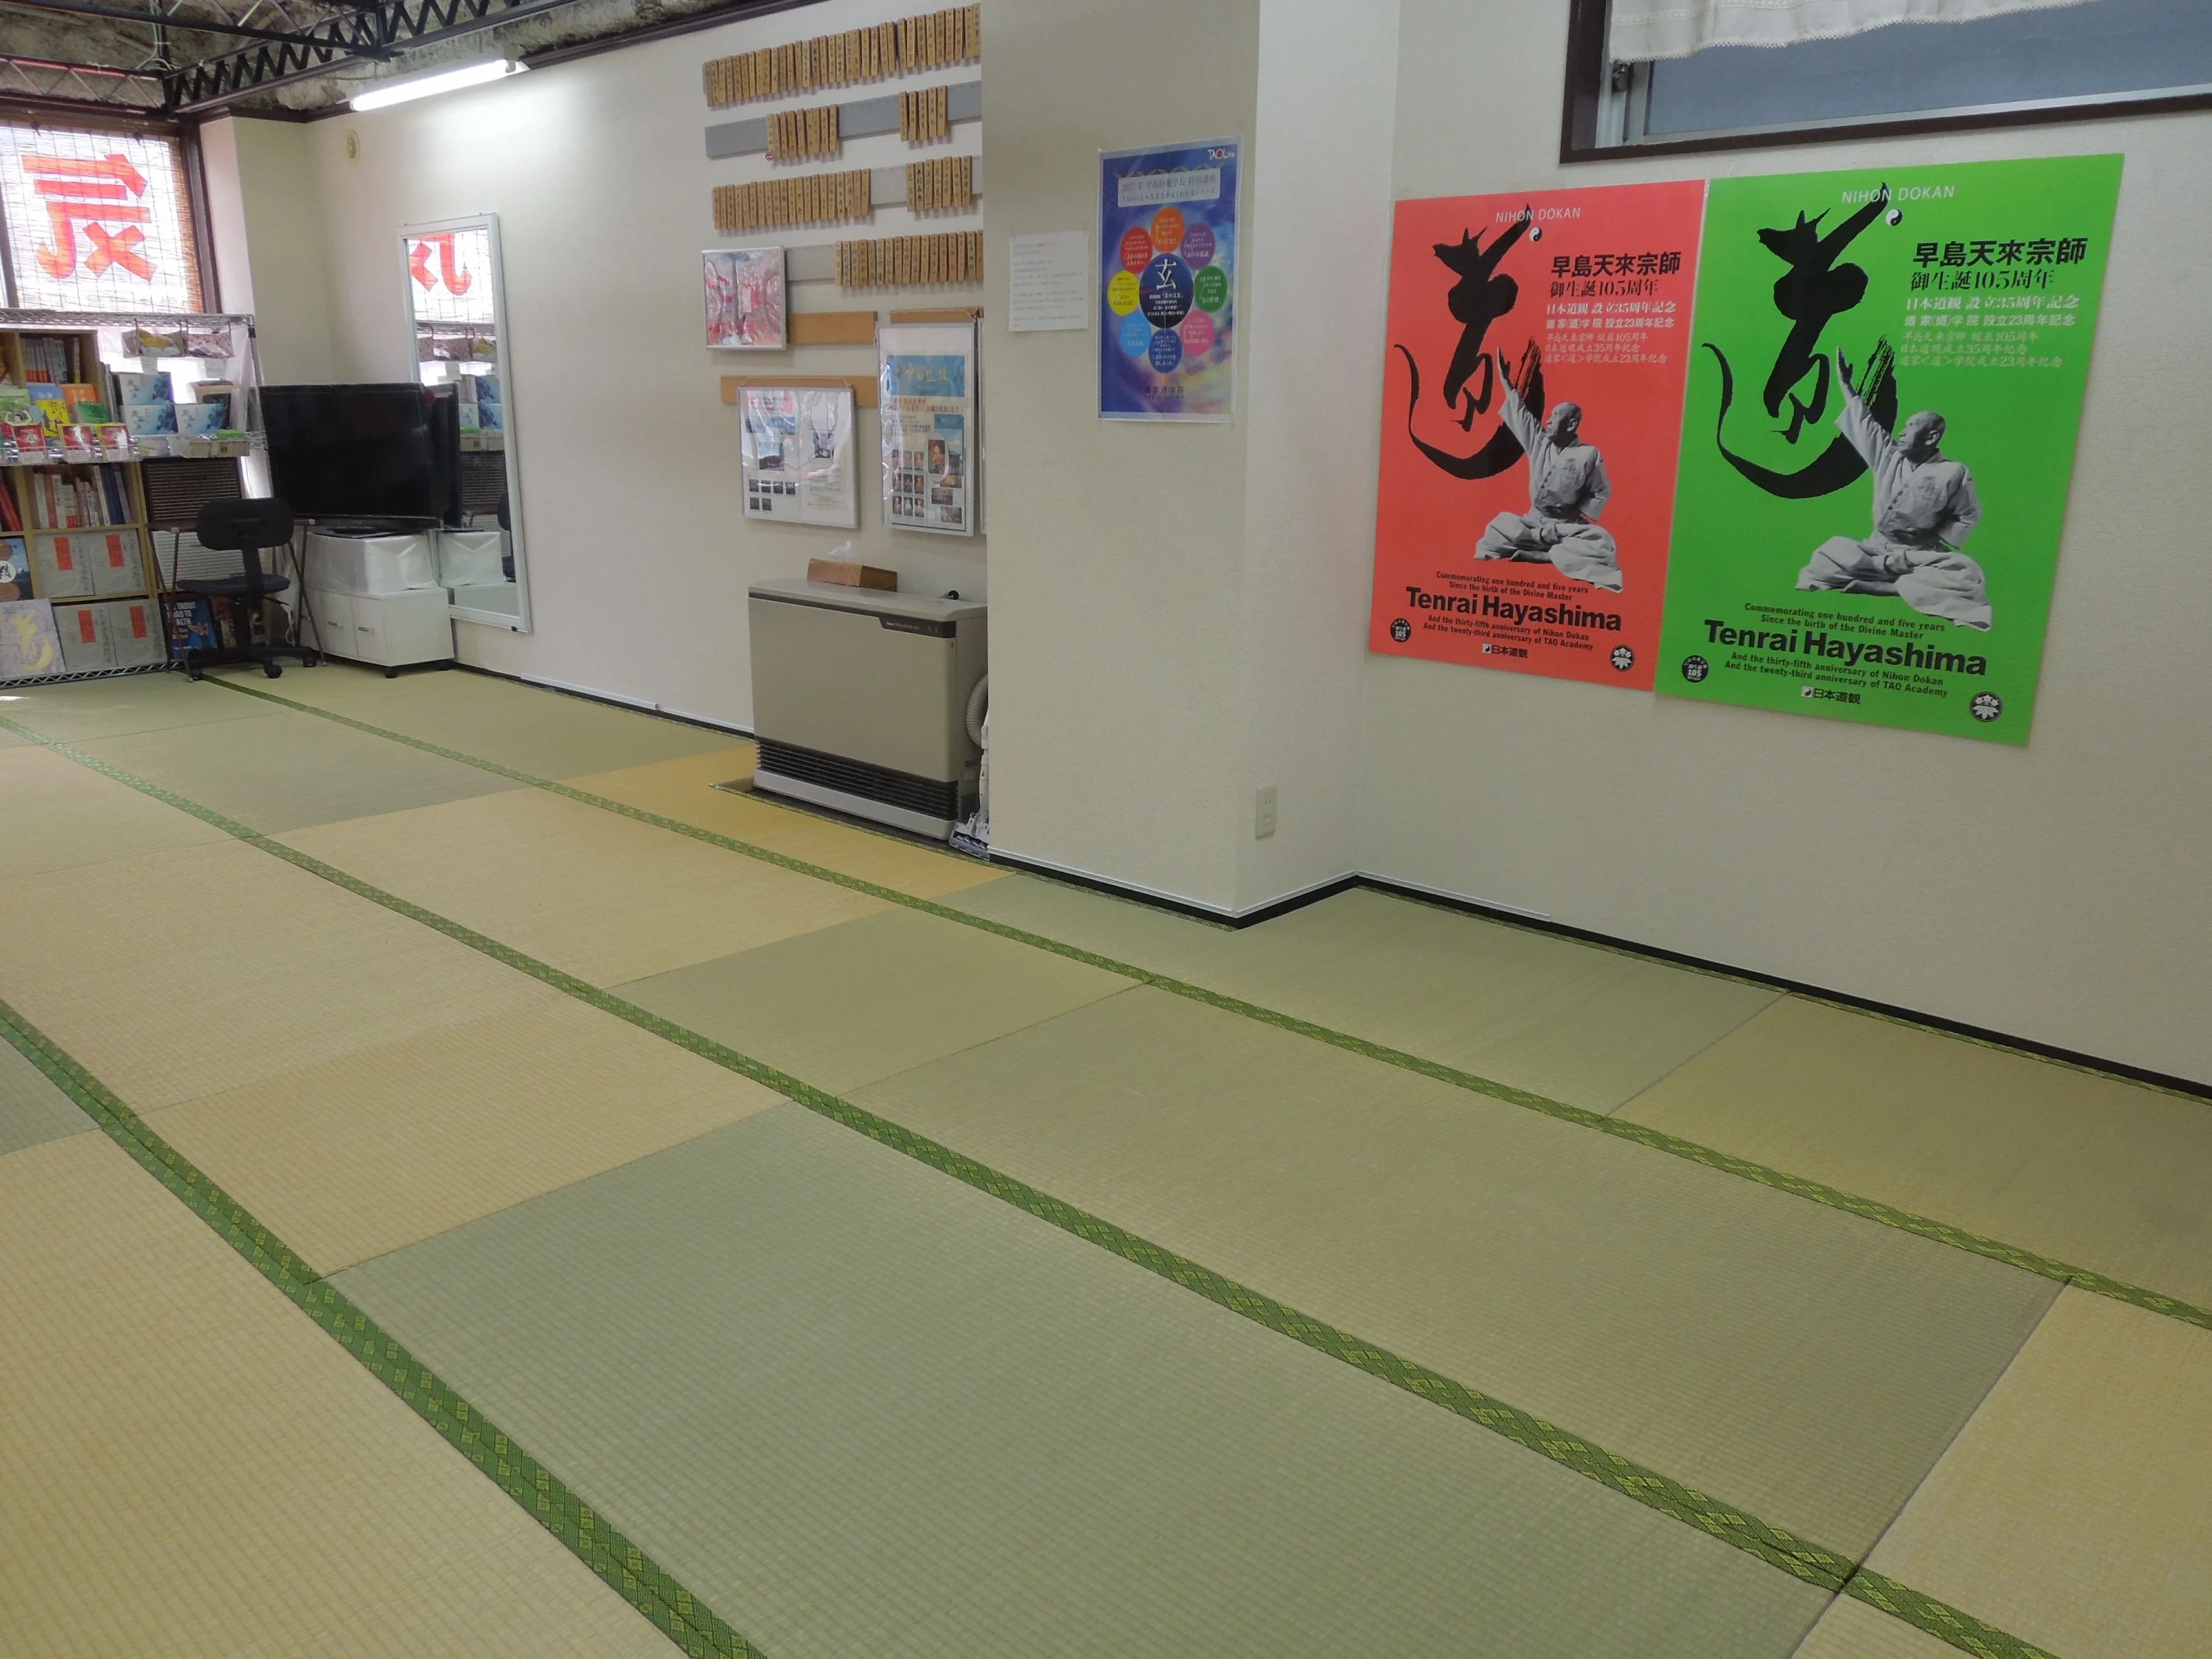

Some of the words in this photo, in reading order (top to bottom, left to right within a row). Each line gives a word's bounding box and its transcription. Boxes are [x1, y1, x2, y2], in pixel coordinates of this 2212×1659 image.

[1842, 189, 1892, 204] NIHON
[1899, 186, 1955, 201] DOKAN
[1496, 209, 1534, 223] NIHON
[1539, 207, 1581, 220] DOKAN
[1551, 251, 1682, 278] 早島天來宗師
[1913, 237, 2088, 268] 早島天來宗師
[1155, 258, 1177, 290] 玄
[1910, 268, 2055, 291] 御生誕105周年
[1550, 279, 1658, 298] 御生誕105周年
[1436, 571, 1489, 584] Commemorating
[1506, 579, 1534, 588] hundred
[1553, 582, 1566, 591] five
[1450, 581, 1467, 589] Since
[1483, 585, 1498, 593] birth
[1523, 589, 1544, 598] Divine
[1406, 586, 1478, 614] Tenrai
[1482, 594, 1621, 631] Hayashima
[1745, 602, 1815, 619] Commemorating
[1818, 611, 1834, 620] one
[1837, 613, 1874, 624] hundred
[1878, 617, 1895, 626] and
[1899, 619, 1916, 629] five
[1919, 623, 1945, 632] years
[1423, 622, 1436, 630] And
[1450, 626, 1490, 637] twenty-third
[1492, 632, 1531, 644] anniversary
[1544, 637, 1558, 646] TAO
[1560, 639, 1593, 651] Academy
[1443, 616, 1453, 624] the
[1455, 618, 1489, 628] thirty-fifth
[1492, 624, 1531, 635] anniversary
[1543, 627, 1563, 638] Nihon
[1566, 631, 1590, 640] Dokan
[1761, 613, 1784, 625] Since
[1787, 617, 1801, 626] the
[1804, 619, 1826, 629] birth
[1829, 622, 1837, 630] of
[1840, 622, 1855, 632] the
[1859, 625, 1887, 636] Divine
[1891, 628, 1924, 639] Master
[1492, 645, 1528, 658] 日本道観
[1704, 619, 1798, 653] Tenrai
[1804, 630, 1986, 675] Hayashima
[1725, 661, 1741, 670] And
[1744, 662, 1757, 672] the
[1761, 664, 1812, 679] twenty-third
[1815, 673, 1867, 687] anniversary
[1871, 680, 1880, 689] of
[1884, 681, 1902, 691] TAO
[1905, 684, 1948, 698] Academy
[1732, 652, 1747, 661] And
[1750, 653, 1764, 664] the
[1767, 656, 1812, 669] thirty-fifth
[1815, 664, 1866, 677] anniversary
[1870, 669, 1879, 678] of
[1882, 671, 1910, 681] Nihon
[1913, 675, 1944, 686] Dokan
[1814, 688, 1861, 705] 日本道観
